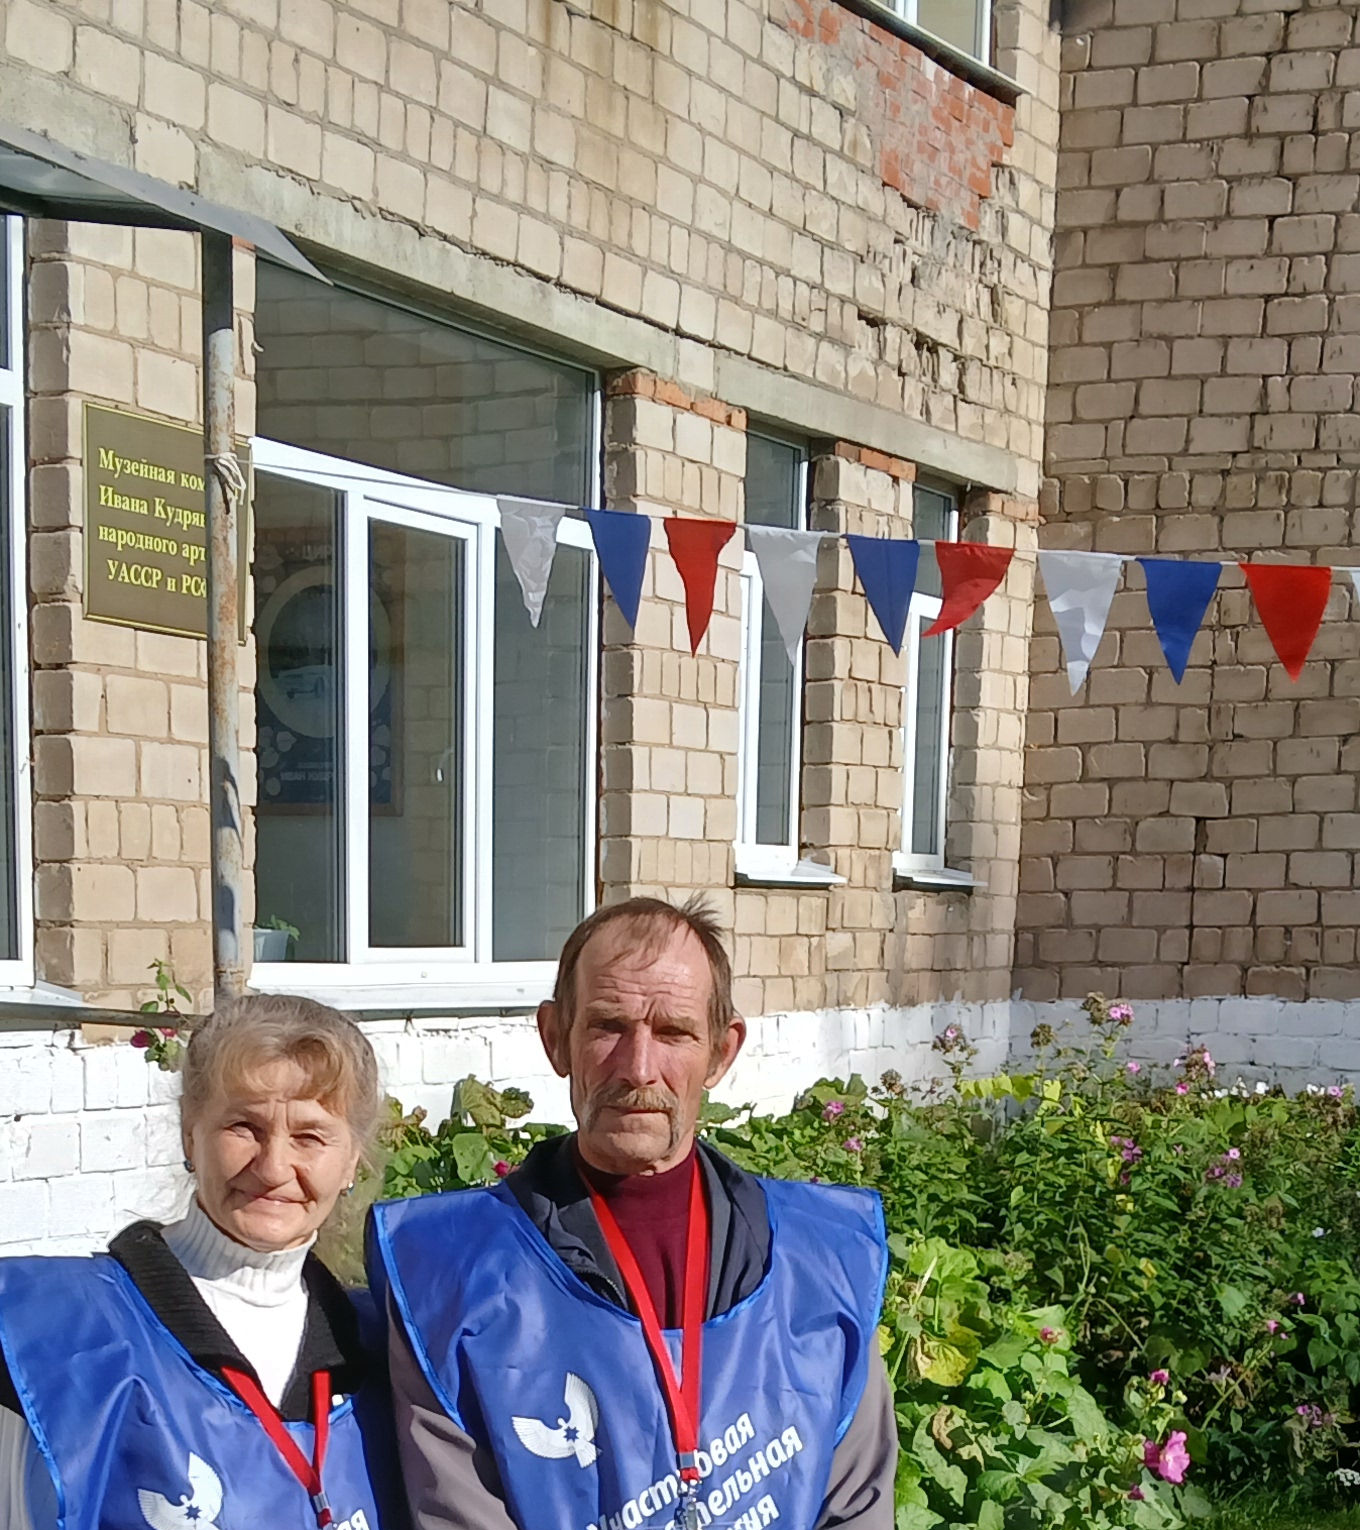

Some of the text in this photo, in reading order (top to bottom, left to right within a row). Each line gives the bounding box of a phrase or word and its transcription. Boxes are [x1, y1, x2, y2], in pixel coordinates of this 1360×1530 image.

[99, 447, 176, 485] Музейная
[99, 484, 149, 515] Ивана
[98, 525, 178, 556] народного
[106, 559, 162, 588] УАССР
[166, 577, 177, 592] и
